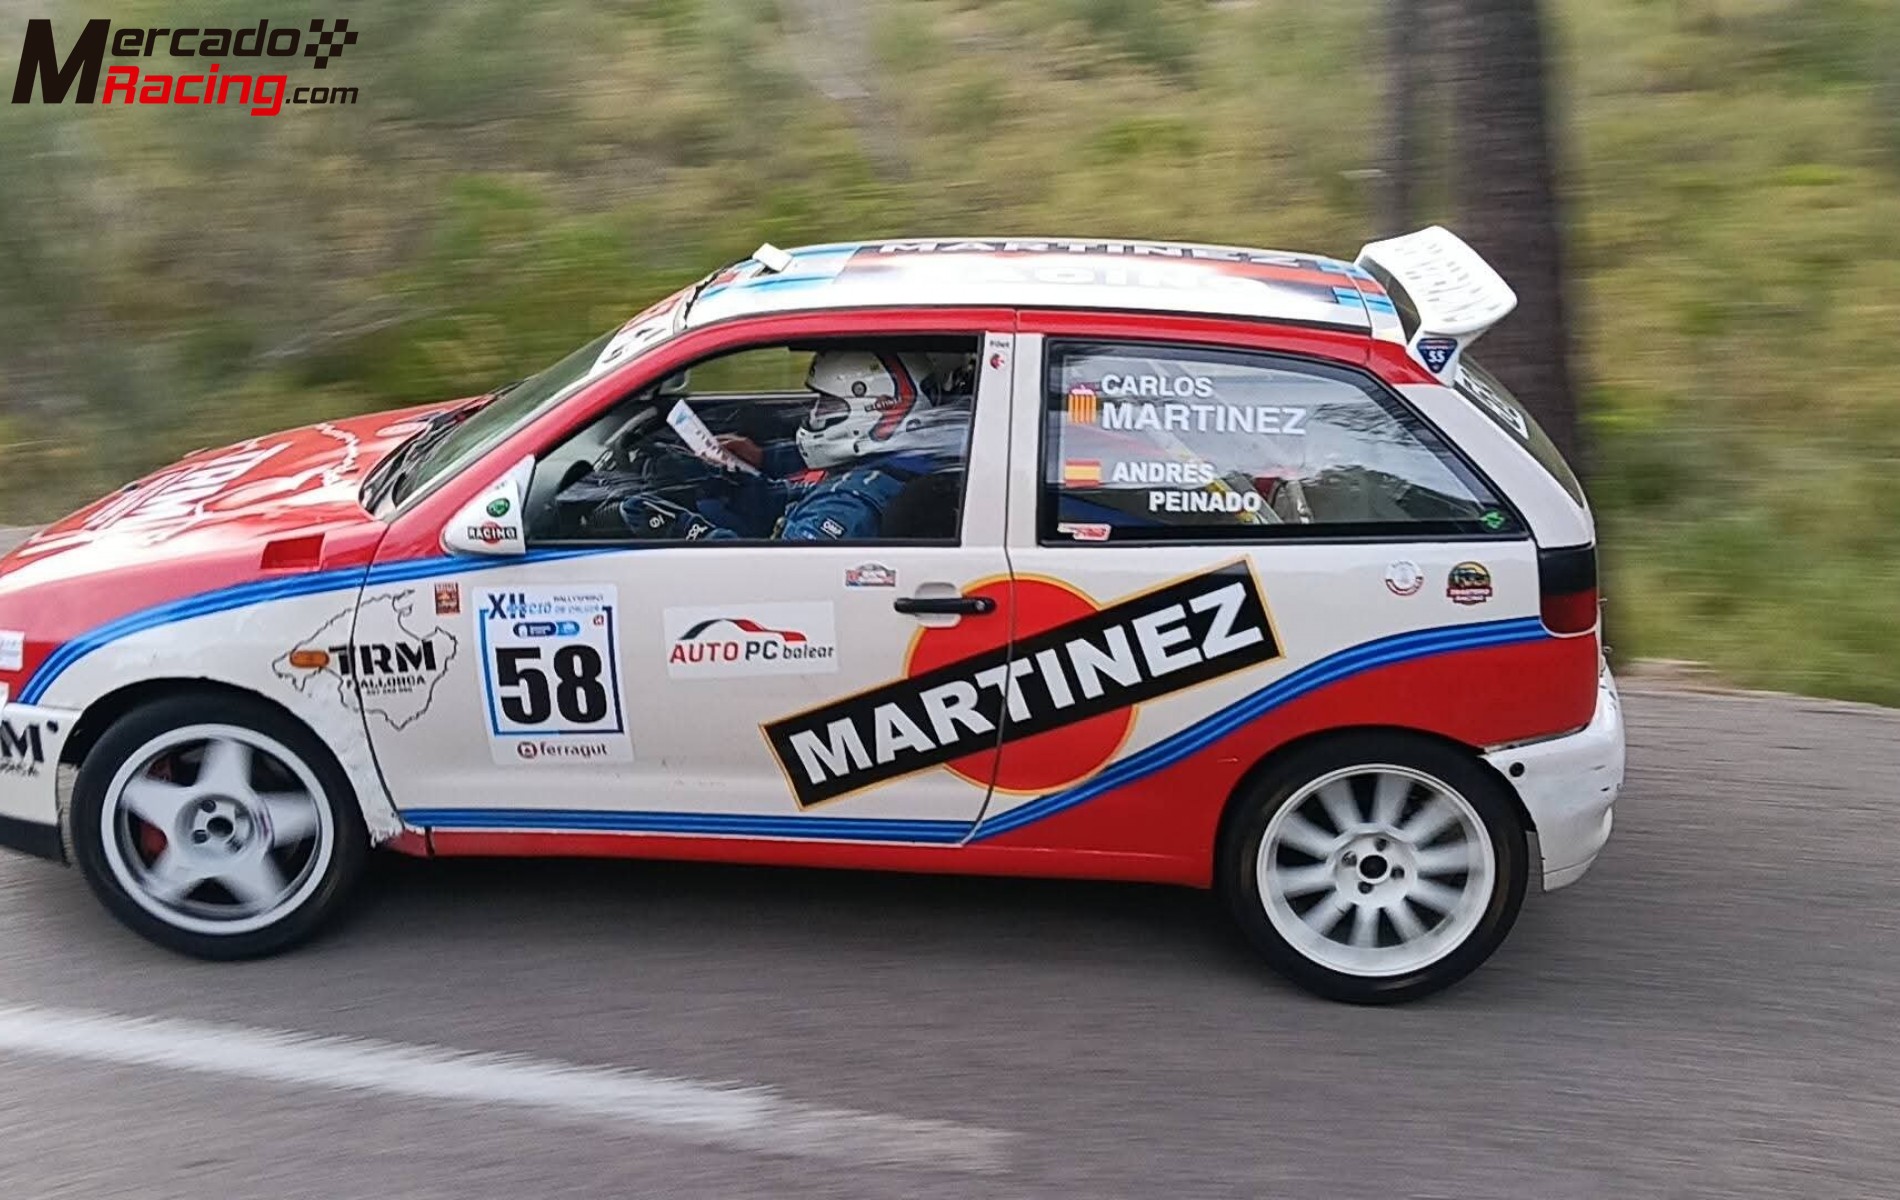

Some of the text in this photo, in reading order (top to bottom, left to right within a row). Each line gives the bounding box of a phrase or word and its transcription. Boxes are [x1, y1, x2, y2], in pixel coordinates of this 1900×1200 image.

[879, 240, 1301, 268] MARTINEZ
[1101, 374, 1213, 398] CARLOS
[1101, 401, 1307, 436] MARTINEZ
[1148, 490, 1262, 513] PEINADO
[467, 526, 518, 541] RACING
[328, 639, 437, 676] TRM
[669, 640, 834, 663] AUTO PC balear
[495, 644, 607, 725] 58
[789, 582, 1264, 785] MARTINEZ
[539, 741, 608, 758] ferragut
